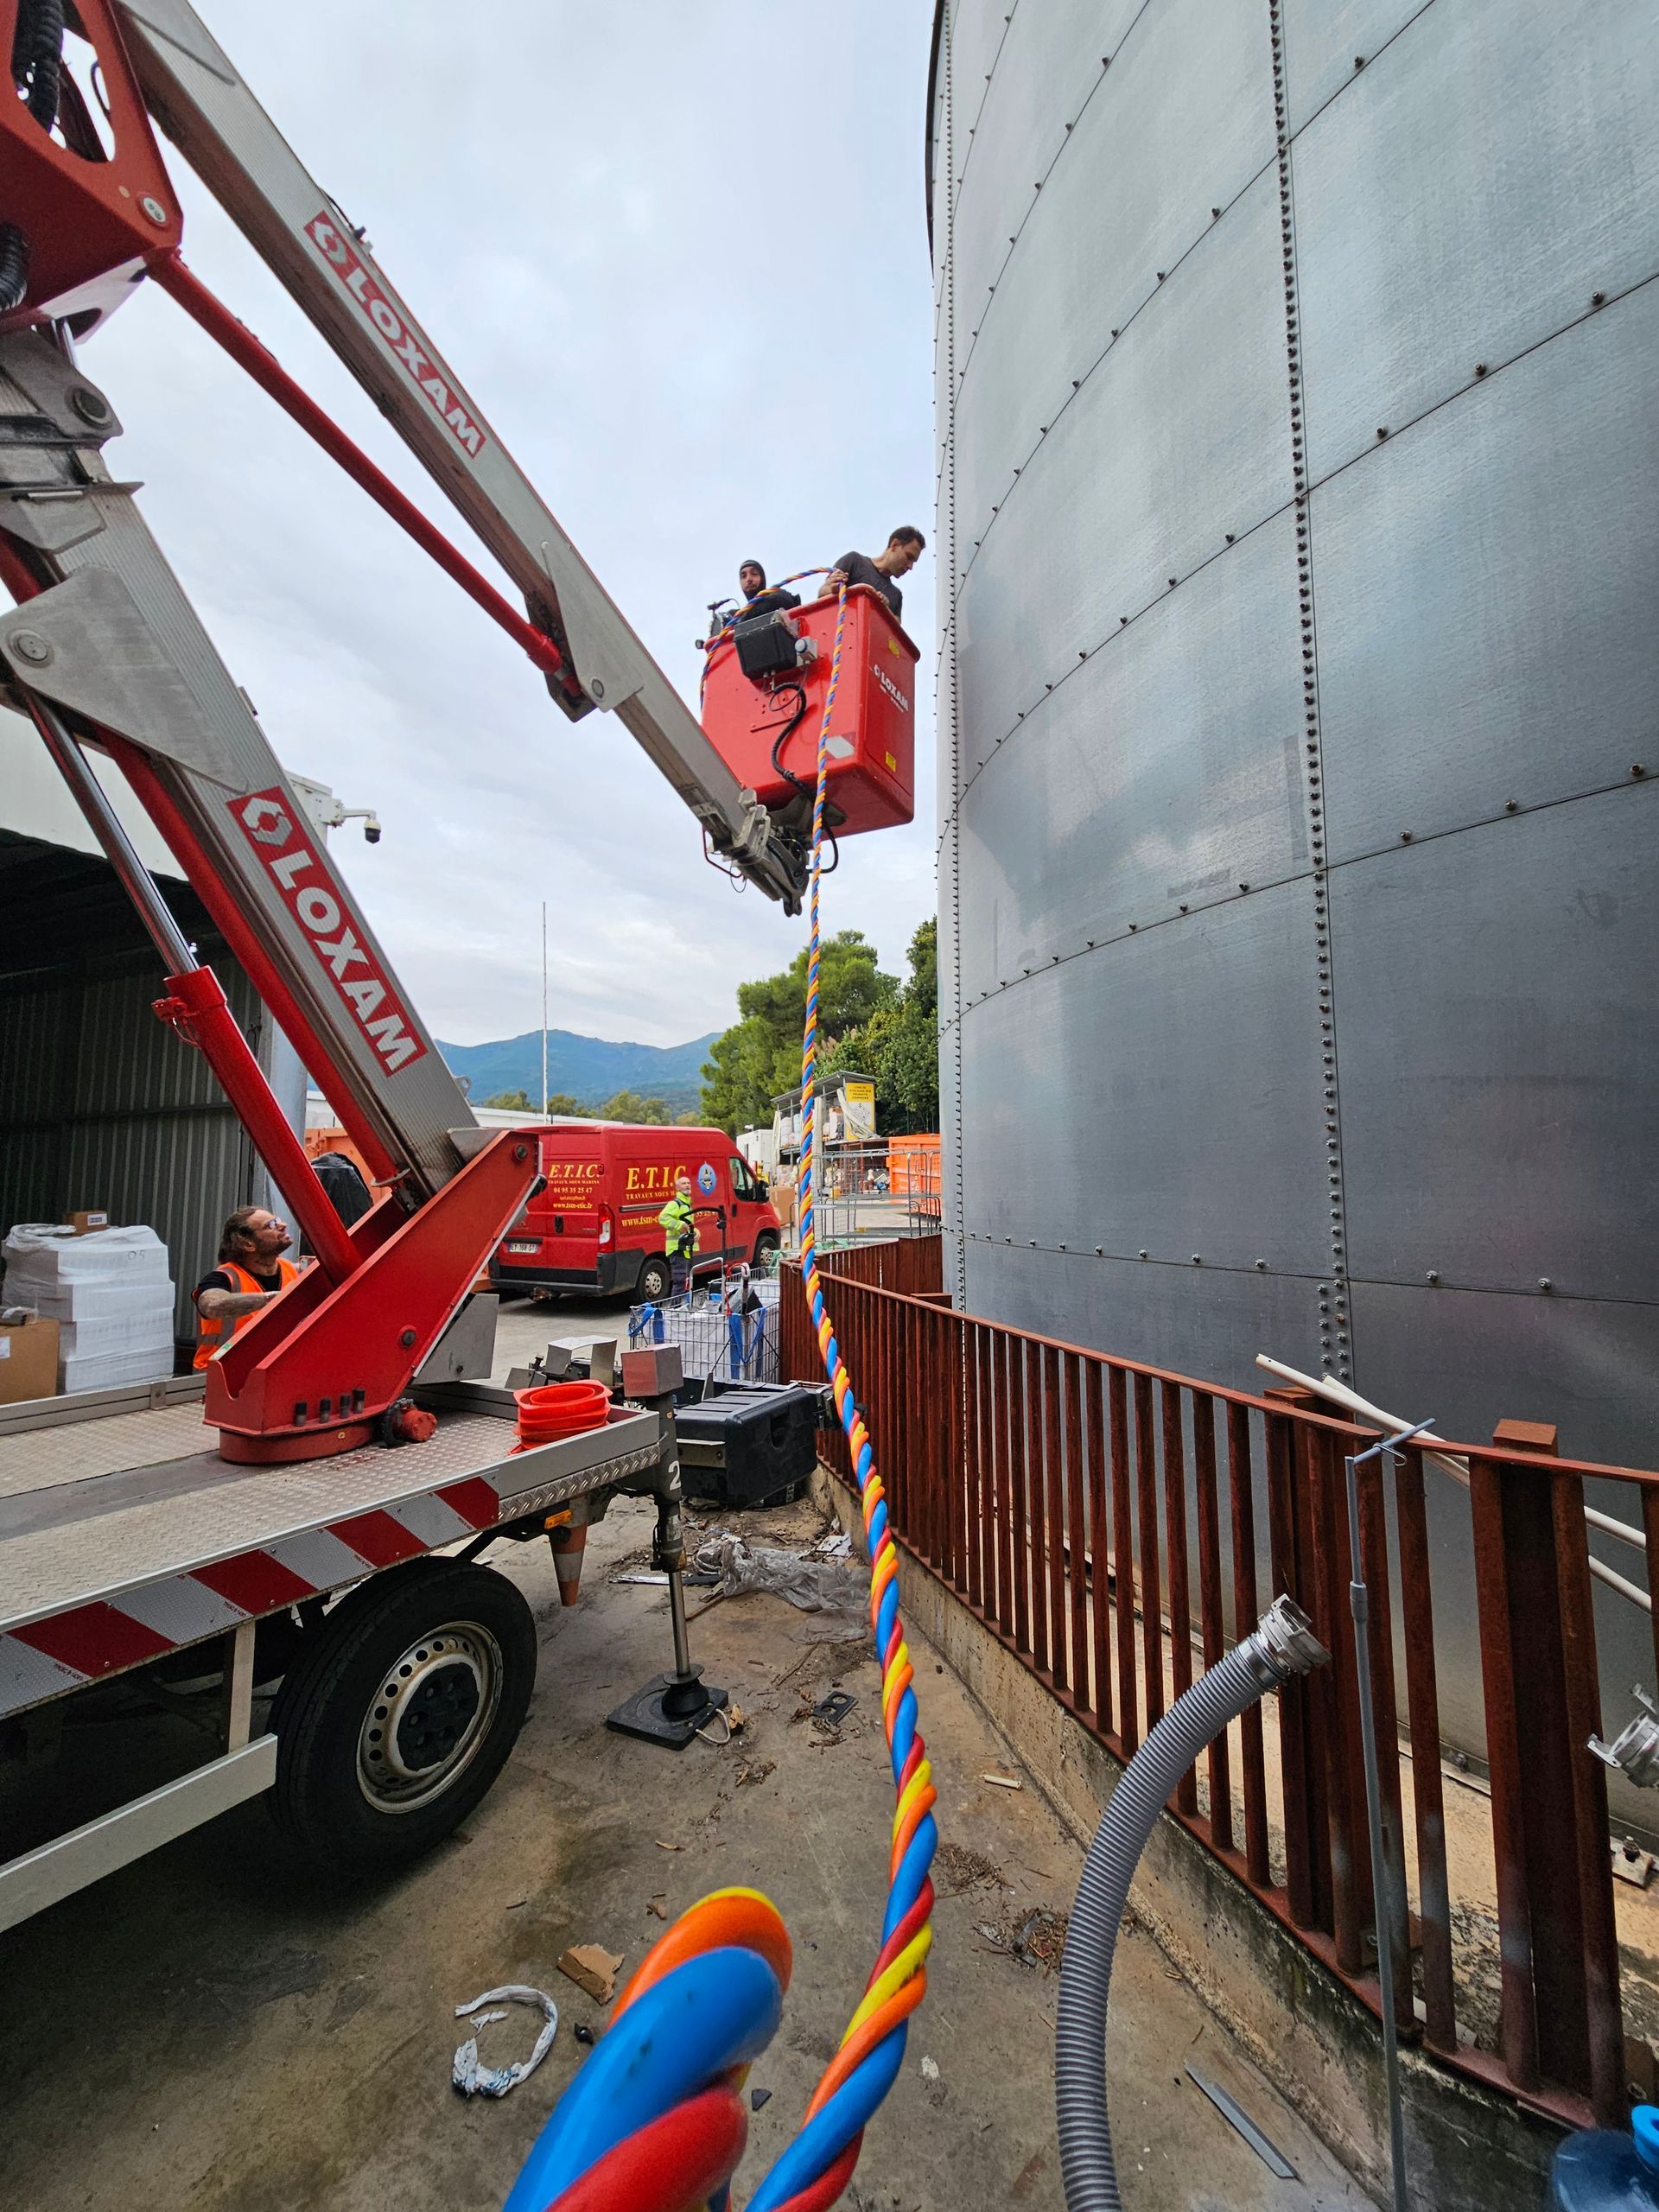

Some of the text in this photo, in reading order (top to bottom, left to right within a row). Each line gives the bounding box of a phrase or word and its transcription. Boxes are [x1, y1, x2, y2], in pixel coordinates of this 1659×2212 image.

[346, 267, 481, 455] LOXAM
[881, 671, 909, 711] LOXAM
[270, 849, 418, 1071] LOXAM
[668, 1460, 682, 1491] 2
